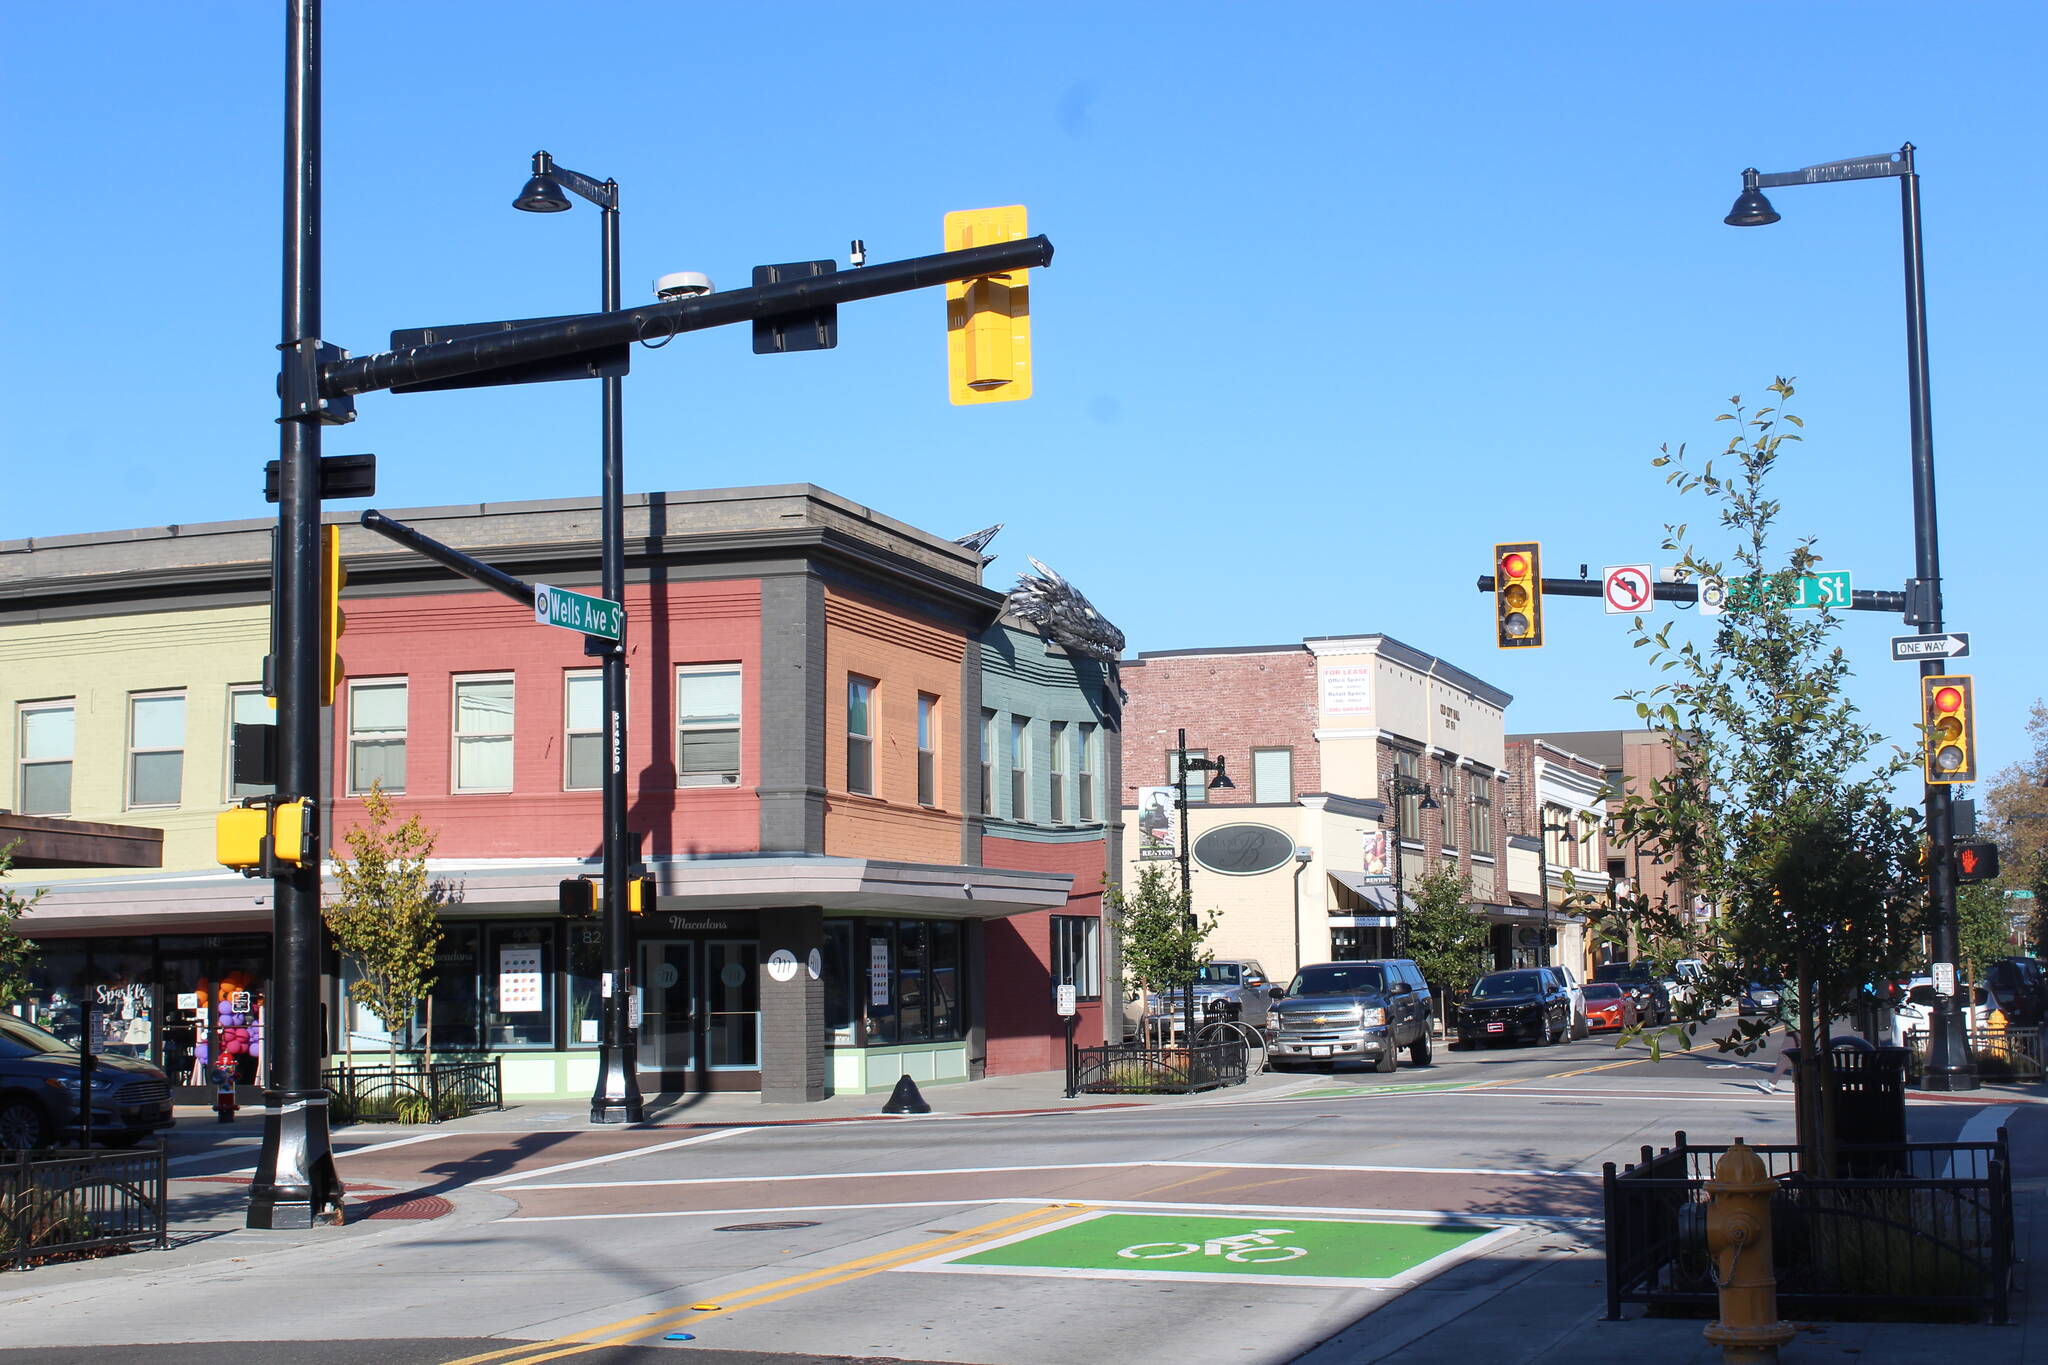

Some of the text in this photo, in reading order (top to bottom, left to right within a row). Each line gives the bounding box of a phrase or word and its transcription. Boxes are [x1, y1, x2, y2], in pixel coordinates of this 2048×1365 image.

[1818, 576, 1845, 604] St
[550, 592, 581, 626] Wells
[584, 601, 607, 632] Ave
[610, 607, 619, 634] S
[1899, 641, 1946, 654] ONE WAY
[1343, 668, 1369, 676] LEASE
[668, 915, 728, 930] Macadons
[96, 983, 147, 1006] Sparkle
